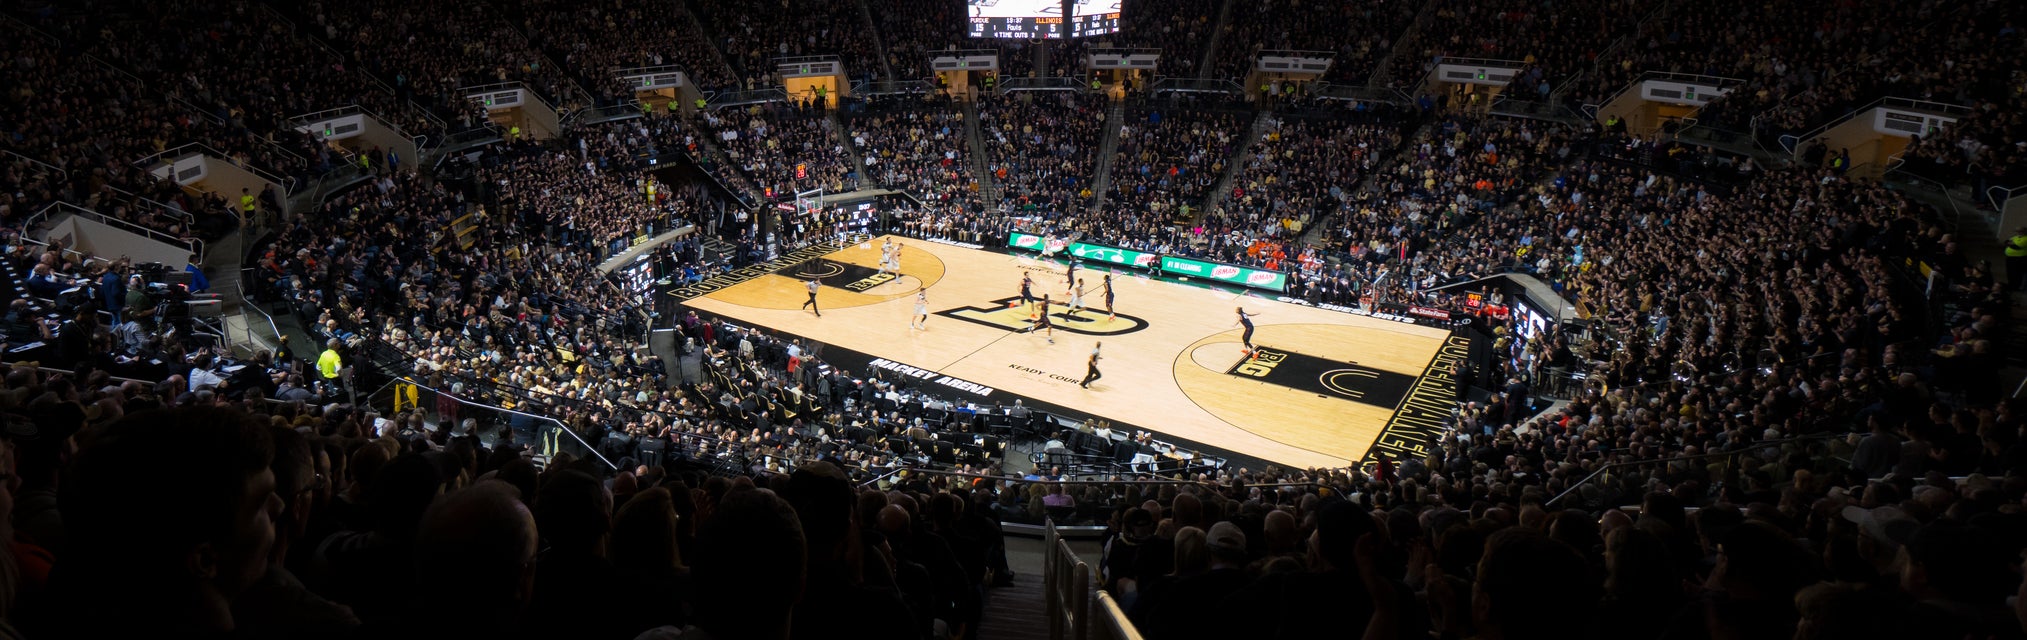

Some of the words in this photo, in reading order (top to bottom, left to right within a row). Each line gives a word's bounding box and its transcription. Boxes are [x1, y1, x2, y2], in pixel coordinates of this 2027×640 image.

[1211, 268, 1237, 278] LIBMAN
[1247, 272, 1274, 283] LIBMAN
[868, 358, 939, 380] MACKEY
[934, 376, 994, 396] ARENA
[1008, 364, 1046, 375] KEADY
[1049, 374, 1080, 384] COUR
